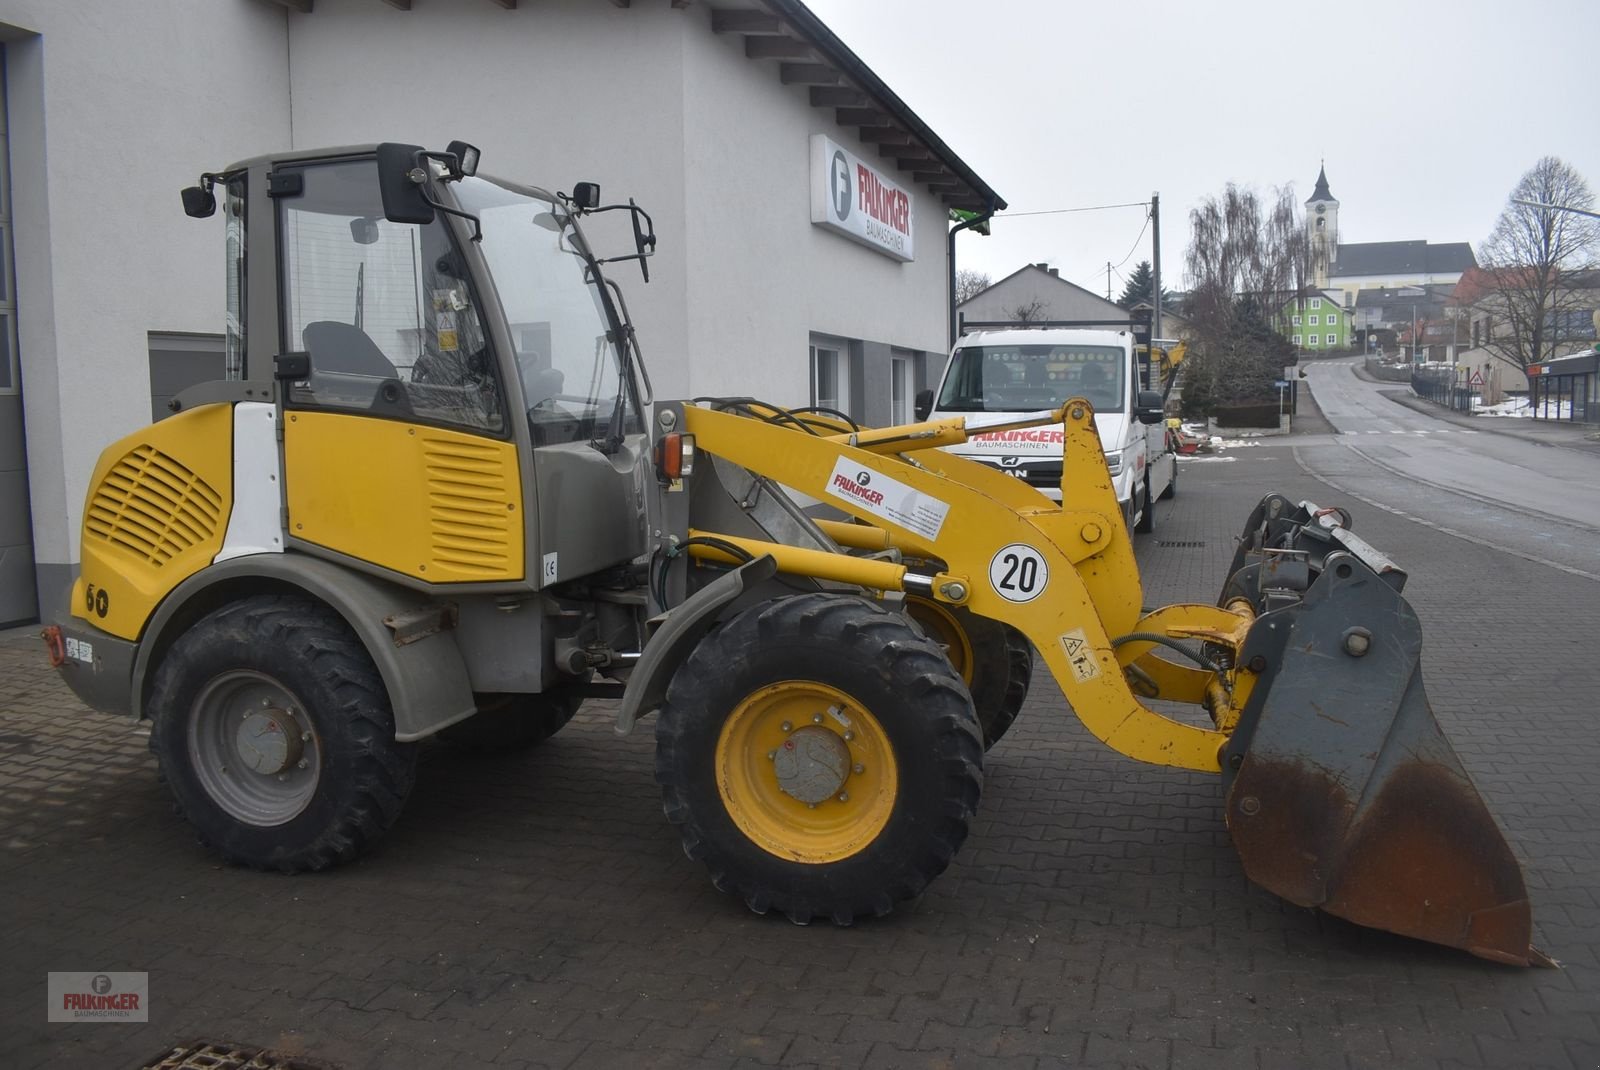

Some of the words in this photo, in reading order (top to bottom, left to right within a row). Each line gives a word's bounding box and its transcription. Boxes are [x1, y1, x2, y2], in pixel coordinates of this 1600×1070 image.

[857, 163, 910, 236] FALKINGER
[866, 219, 904, 250] BAUMASCHINEN
[973, 430, 1064, 443] ALKINGER
[976, 441, 1049, 449] BAUMASCHINEN
[833, 474, 884, 506] FALKINGER
[838, 488, 874, 508] BAUMASCHINEN
[999, 553, 1038, 592] 20
[86, 583, 109, 619] 60
